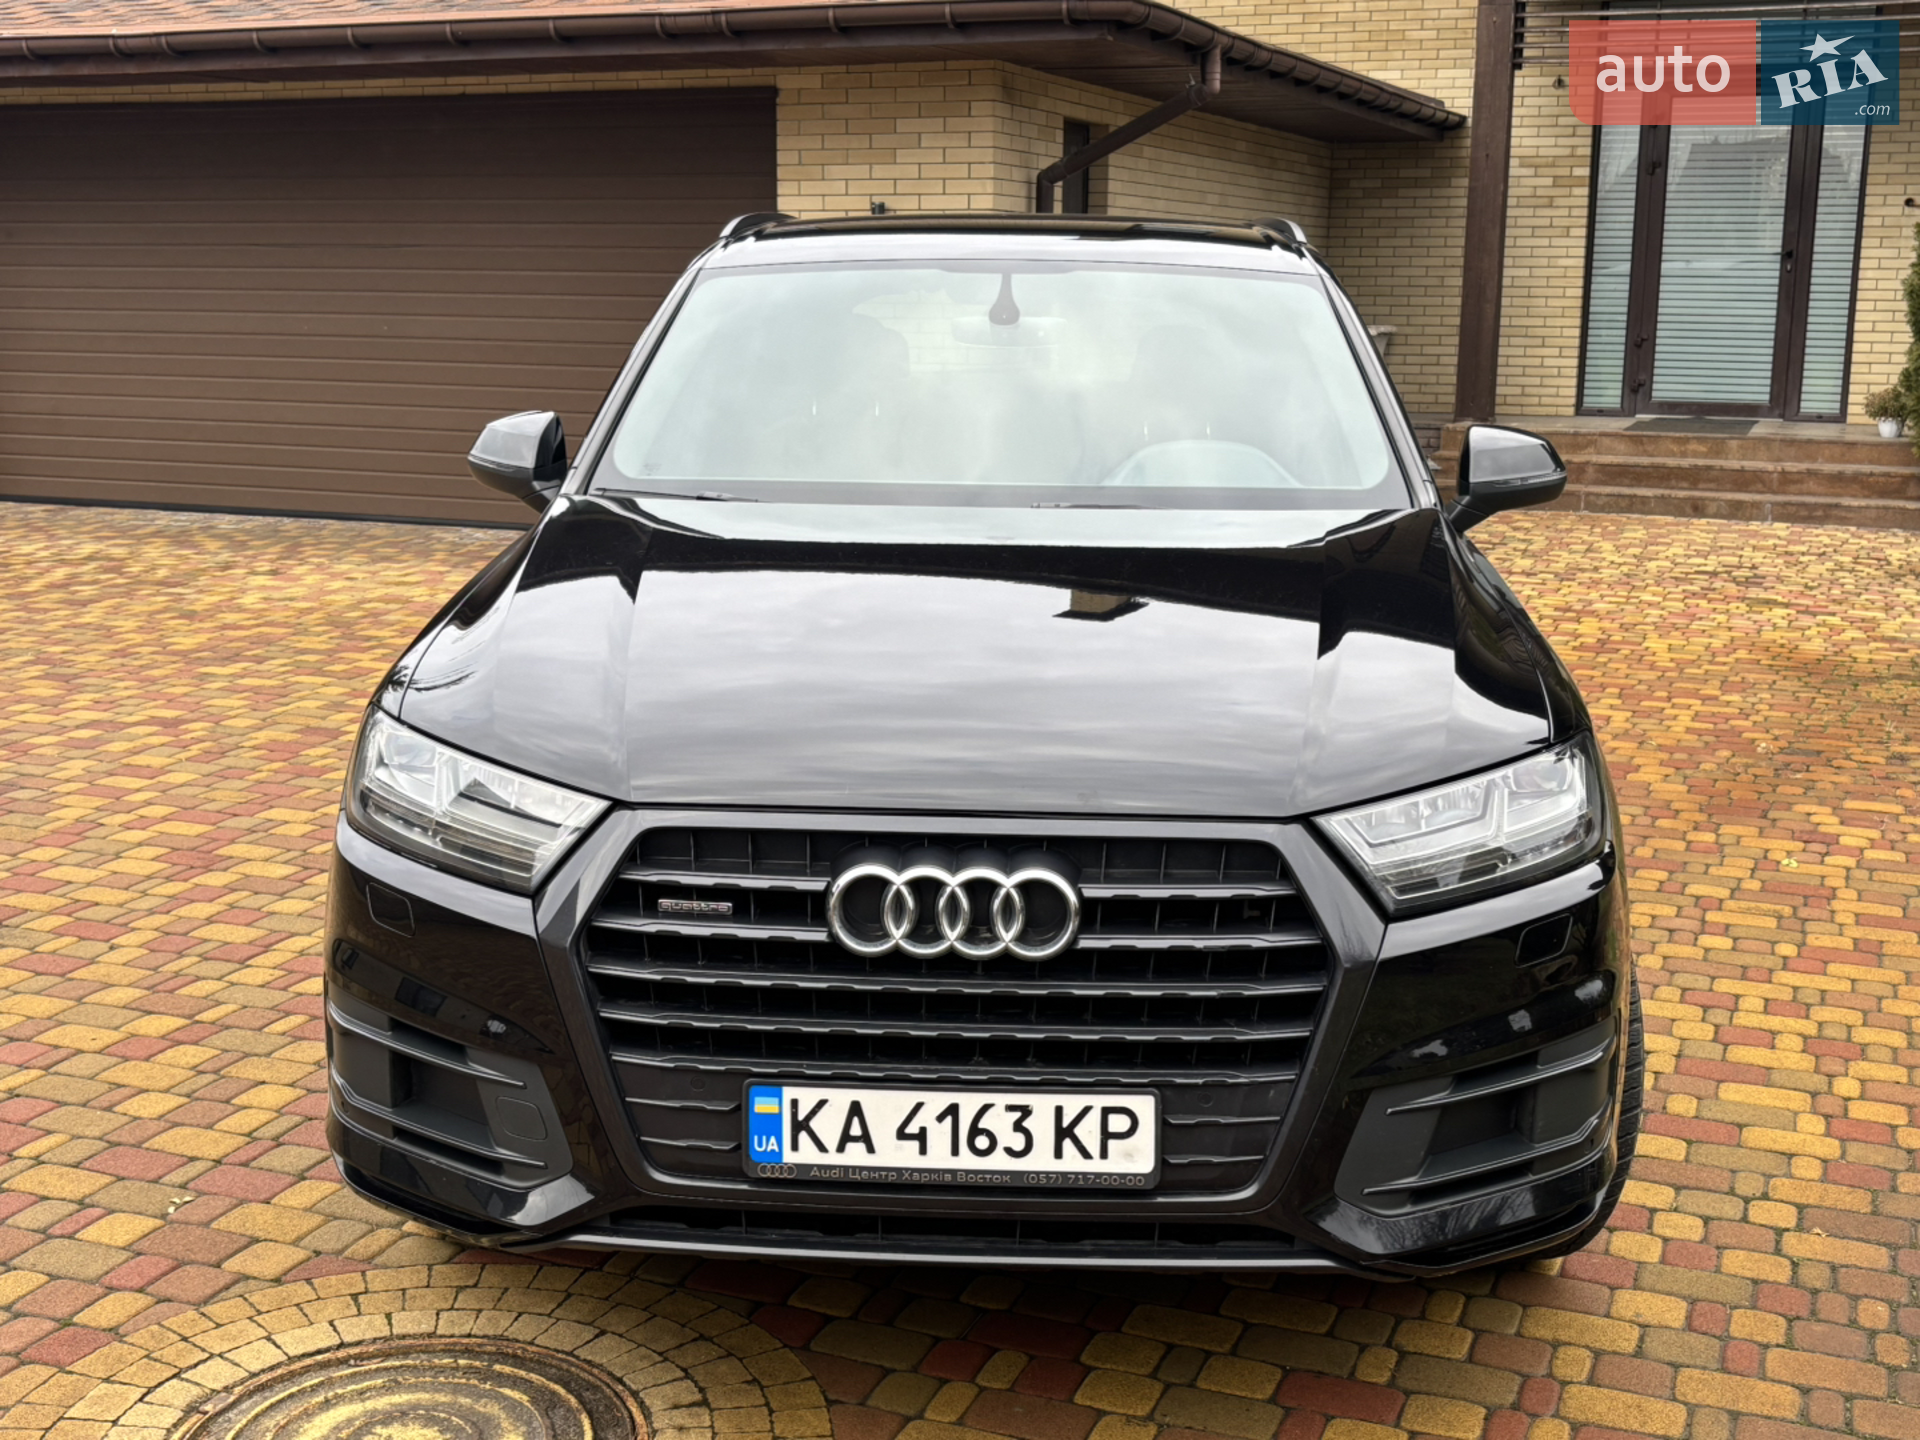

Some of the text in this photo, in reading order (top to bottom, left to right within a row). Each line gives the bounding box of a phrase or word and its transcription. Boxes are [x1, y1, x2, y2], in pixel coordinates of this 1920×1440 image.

[790, 1098, 1140, 1161] KA 4163 KP
[754, 1135, 780, 1152] UA
[809, 1166, 1145, 1186] Audi Центр Харків Восток (057) 717-00-00
